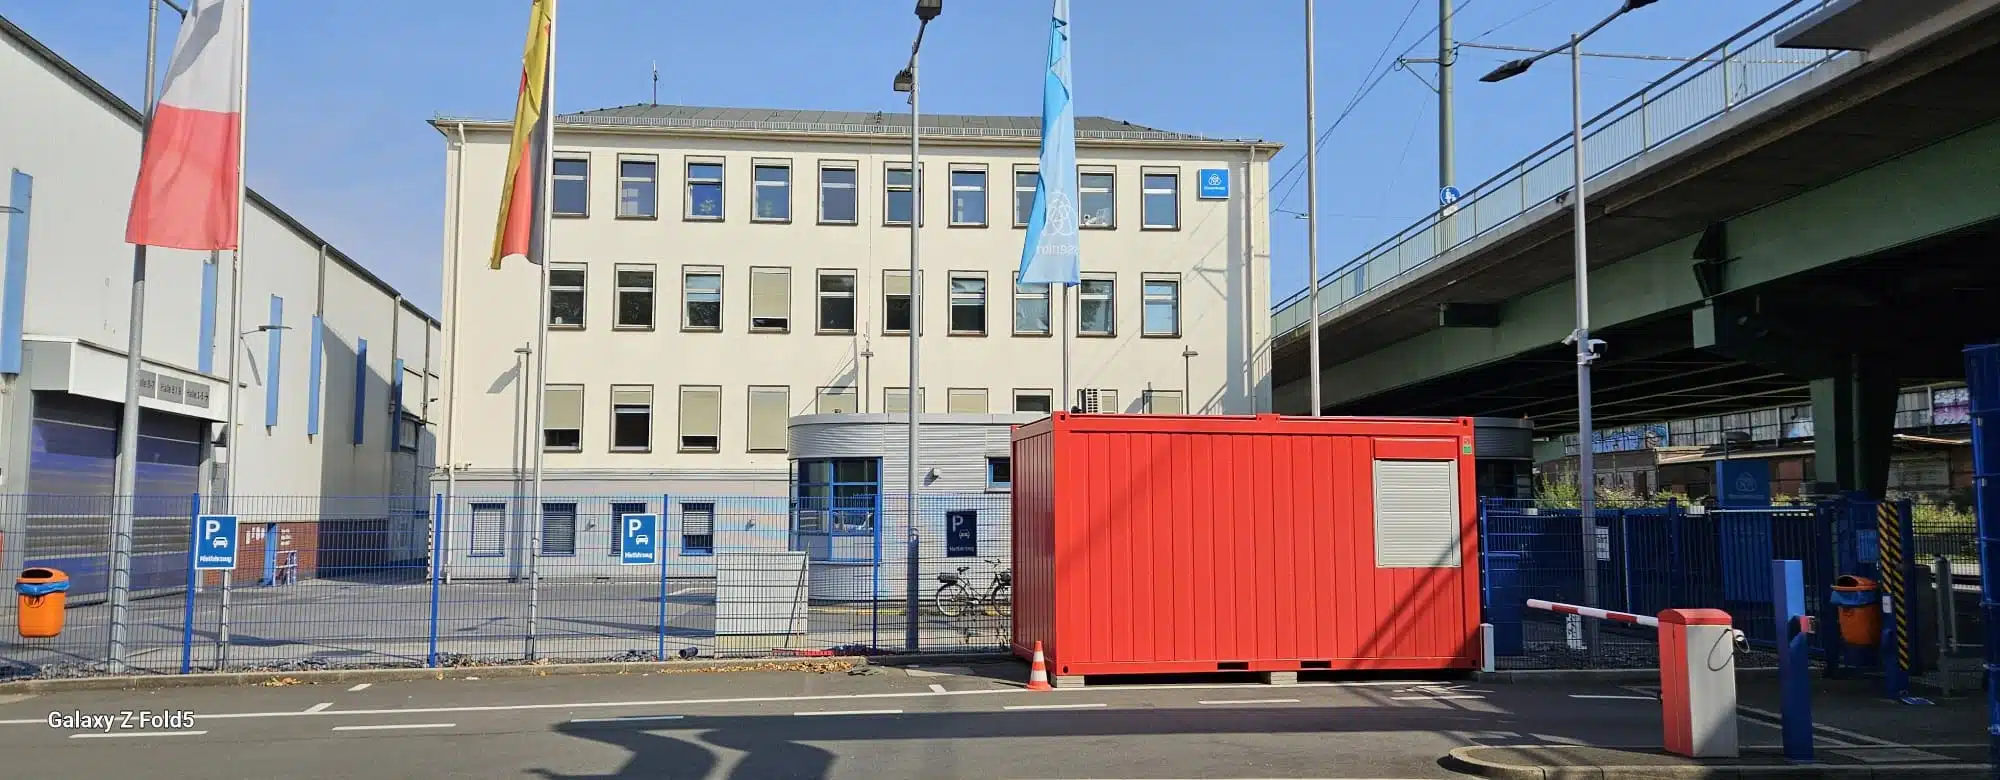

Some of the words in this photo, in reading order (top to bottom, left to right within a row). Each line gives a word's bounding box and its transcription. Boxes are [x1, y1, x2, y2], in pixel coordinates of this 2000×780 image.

[205, 520, 221, 540] P
[628, 519, 642, 538] P
[952, 515, 964, 532] P
